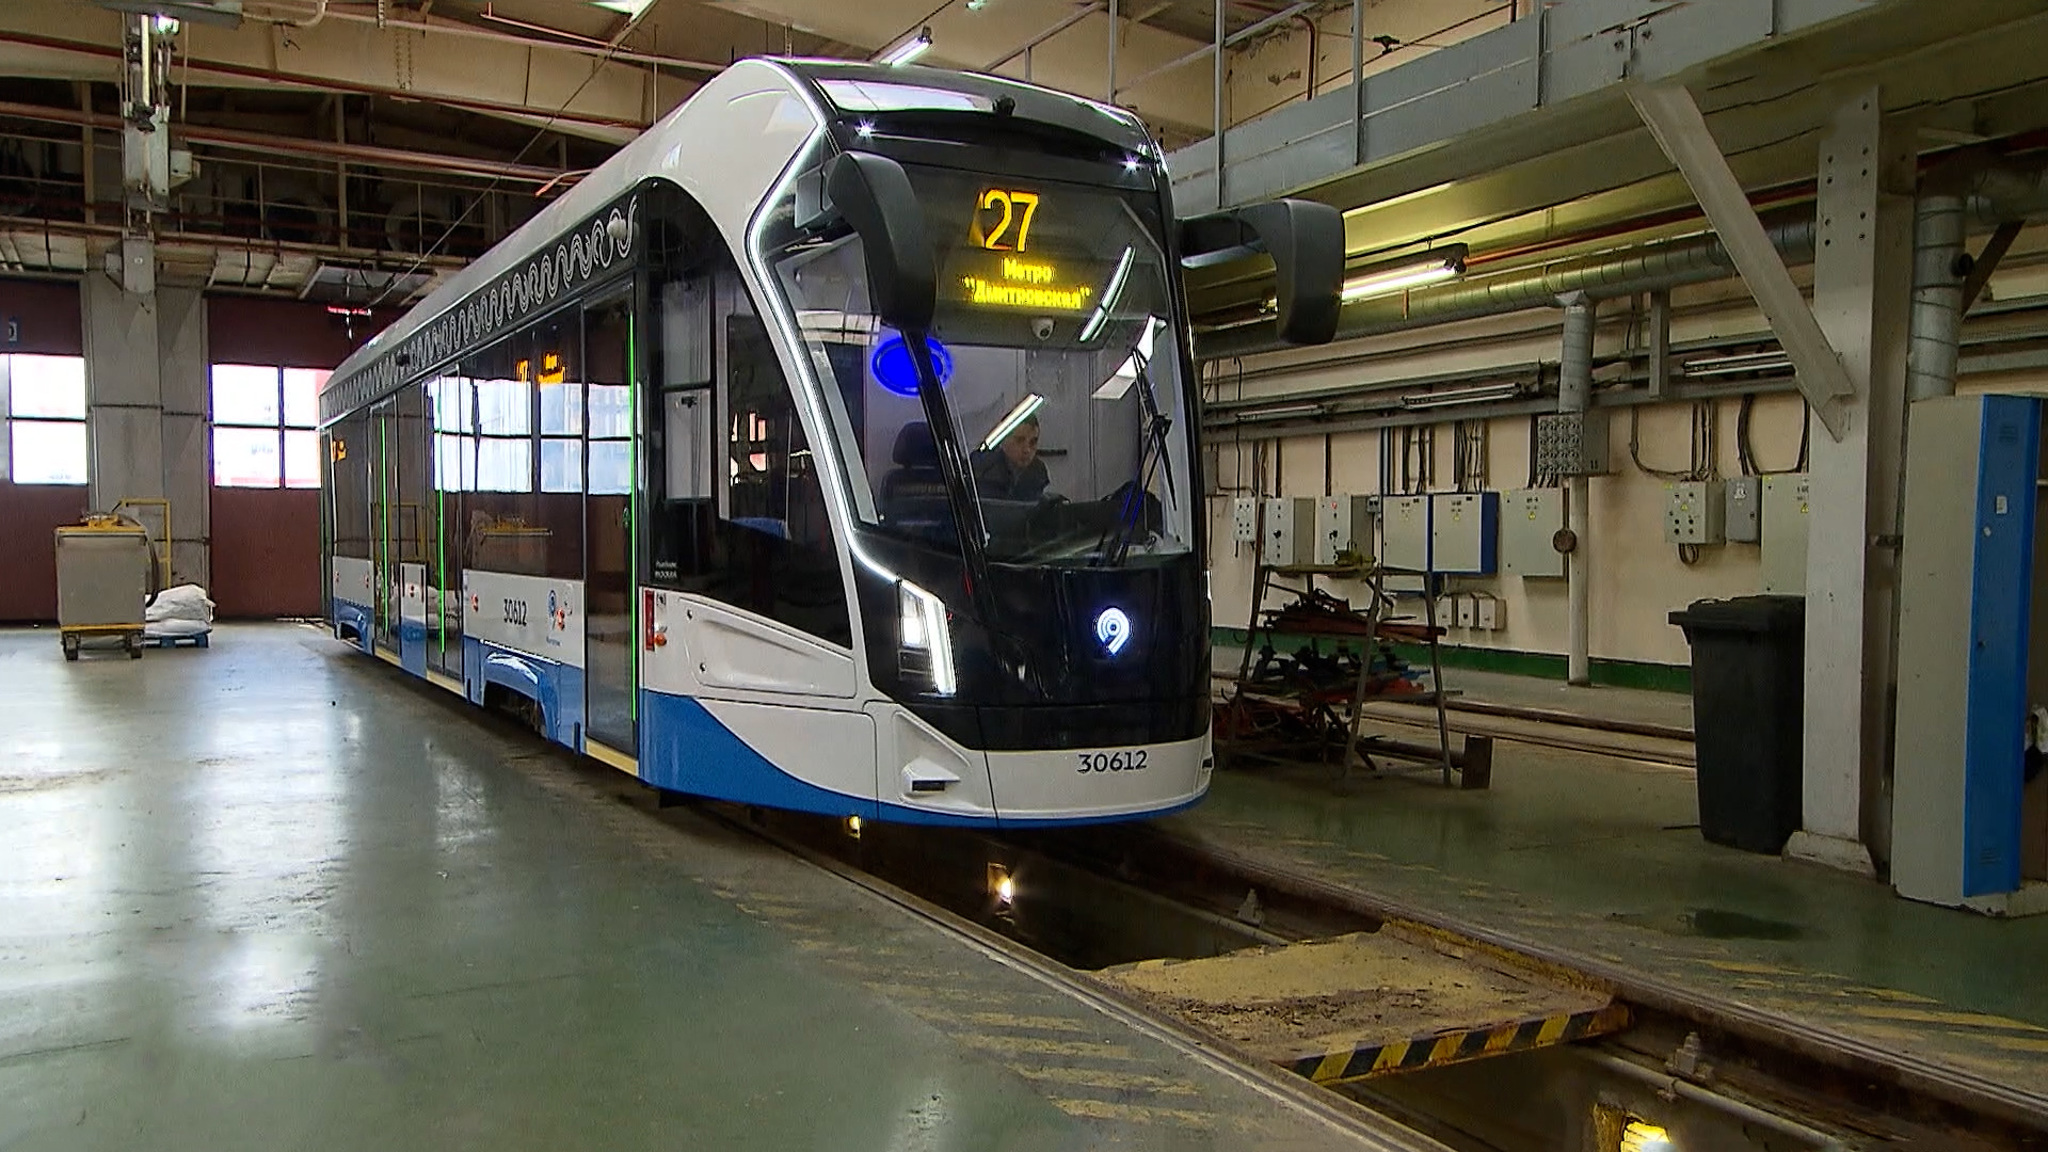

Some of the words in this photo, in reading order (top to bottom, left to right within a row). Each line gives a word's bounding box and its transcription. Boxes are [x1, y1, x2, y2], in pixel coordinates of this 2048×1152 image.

[983, 188, 1040, 252] 27
[503, 598, 527, 627] 30612
[1077, 750, 1148, 775] 30612
